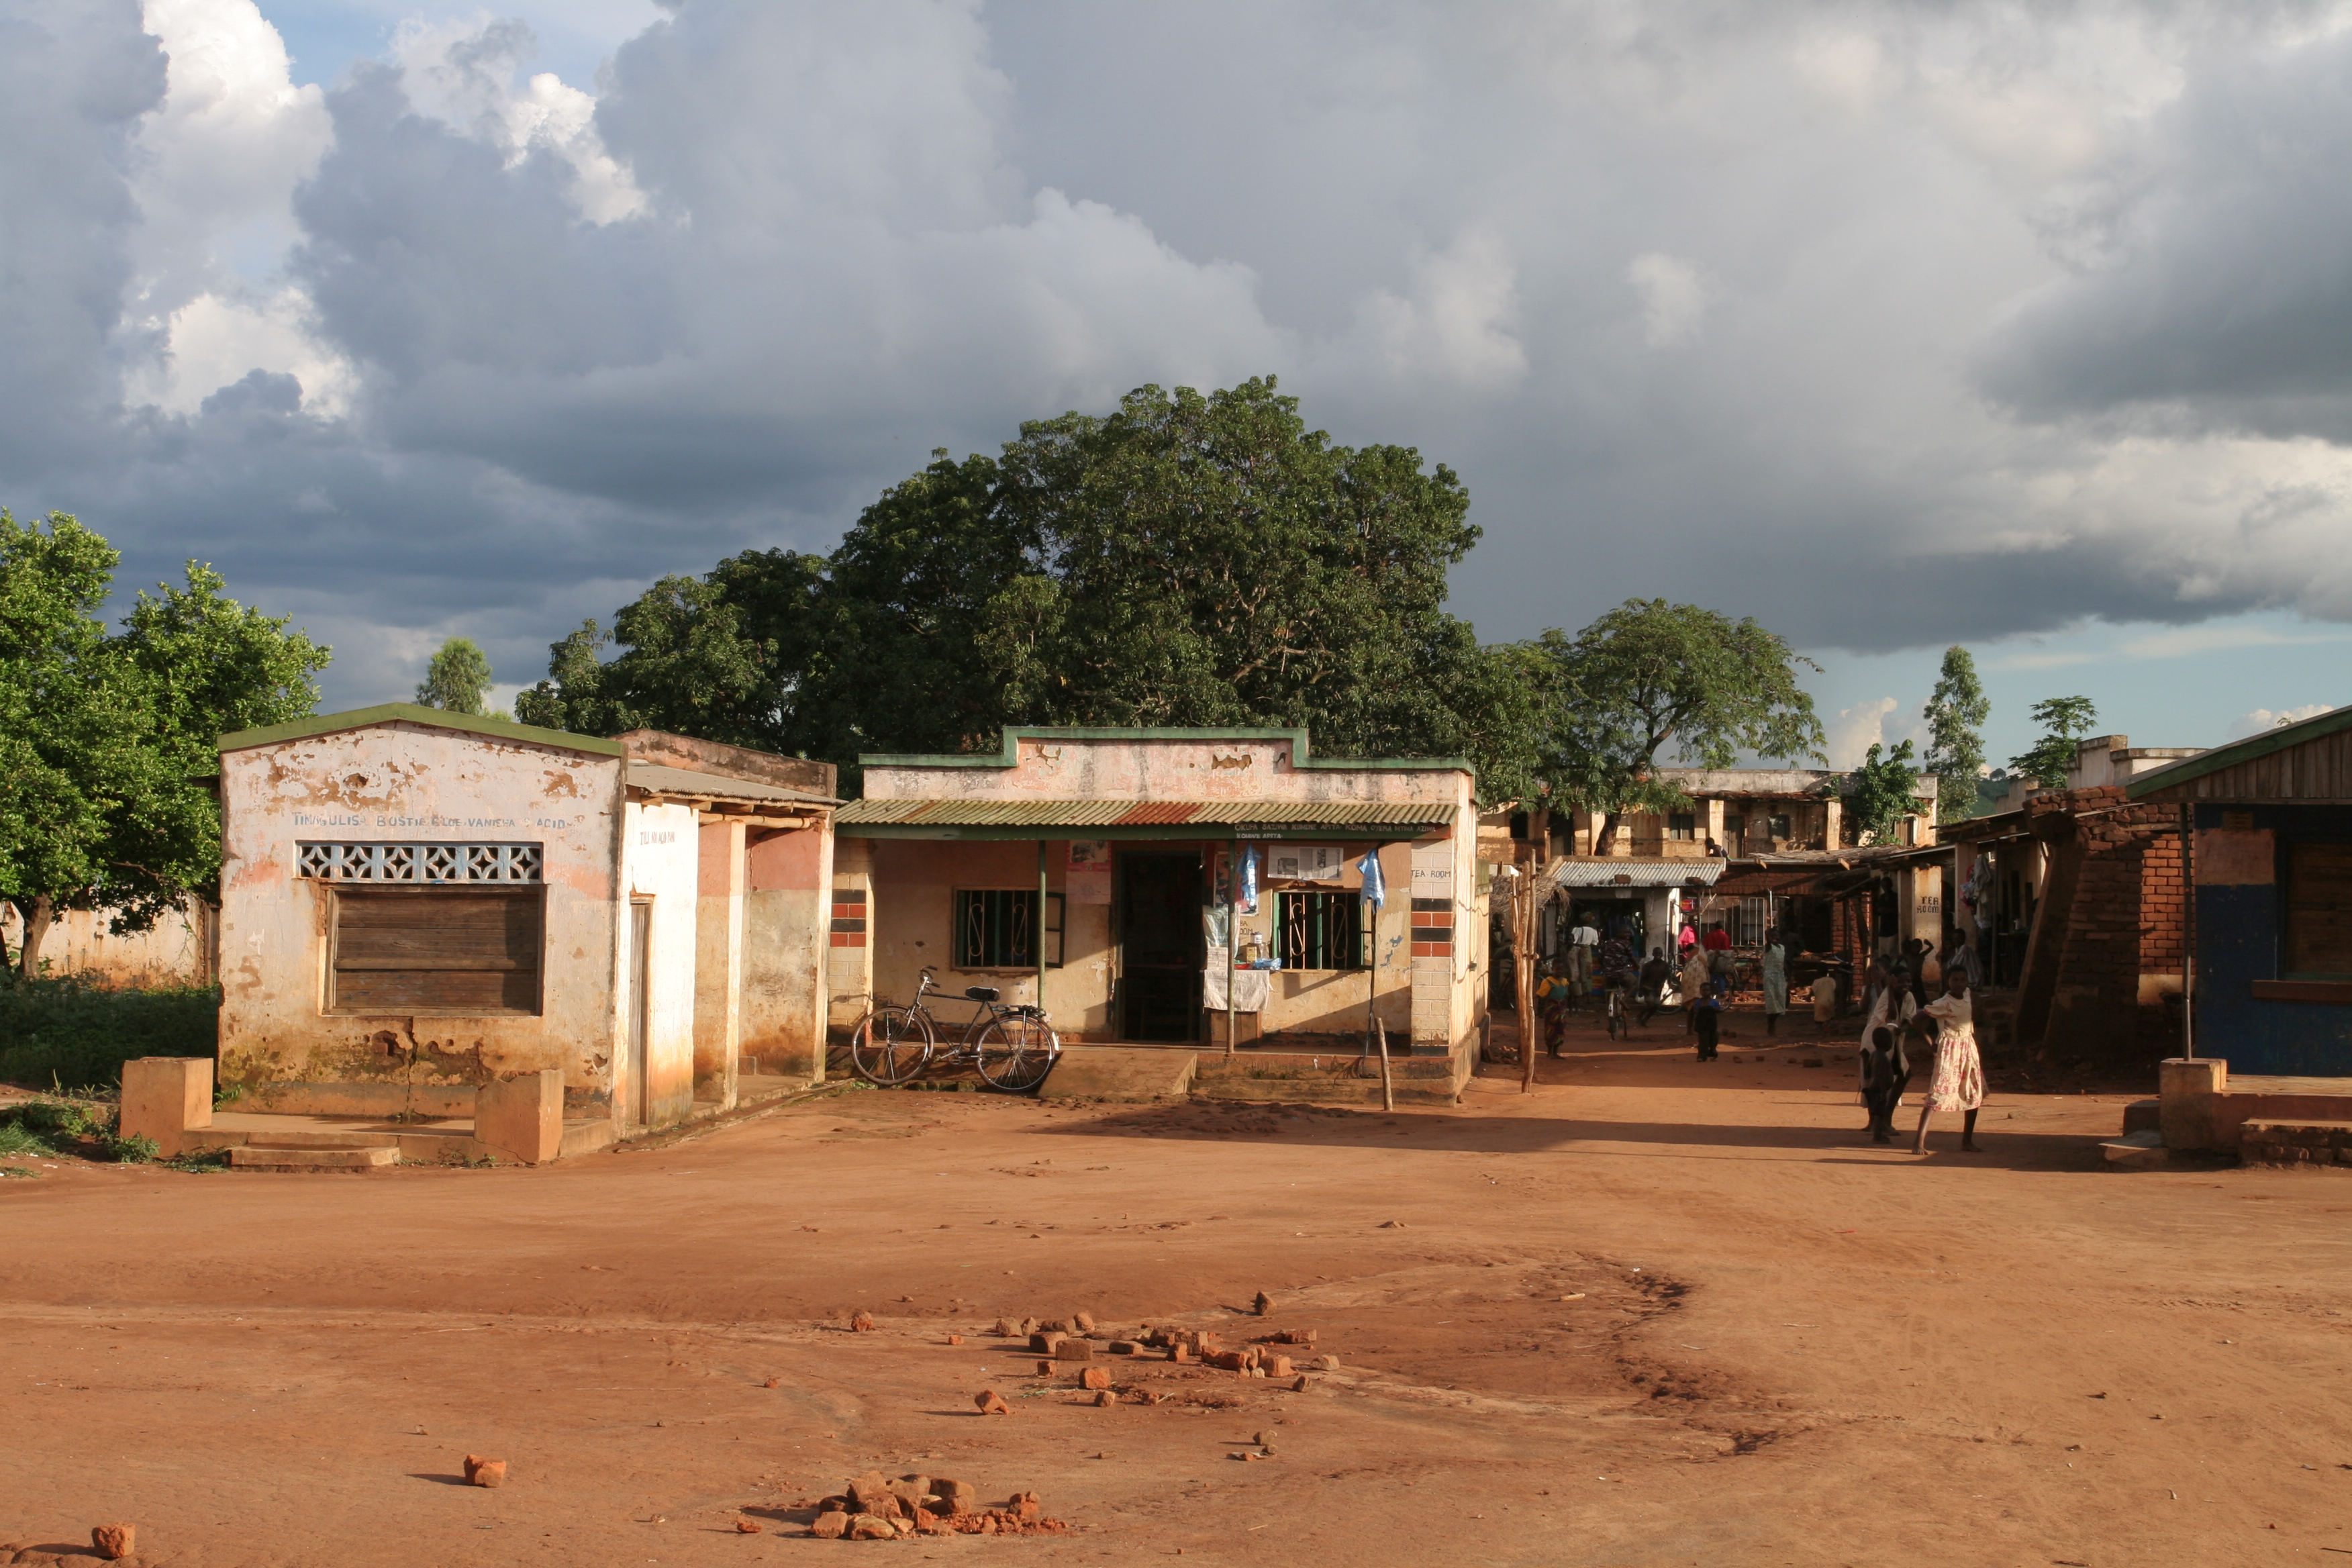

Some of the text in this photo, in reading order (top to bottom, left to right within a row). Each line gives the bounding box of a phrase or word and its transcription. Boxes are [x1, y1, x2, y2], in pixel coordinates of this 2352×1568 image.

[1411, 870, 1451, 878] TEA ROOM
[1920, 895, 1939, 905] TEA
[1916, 905, 1939, 914] ROOM
